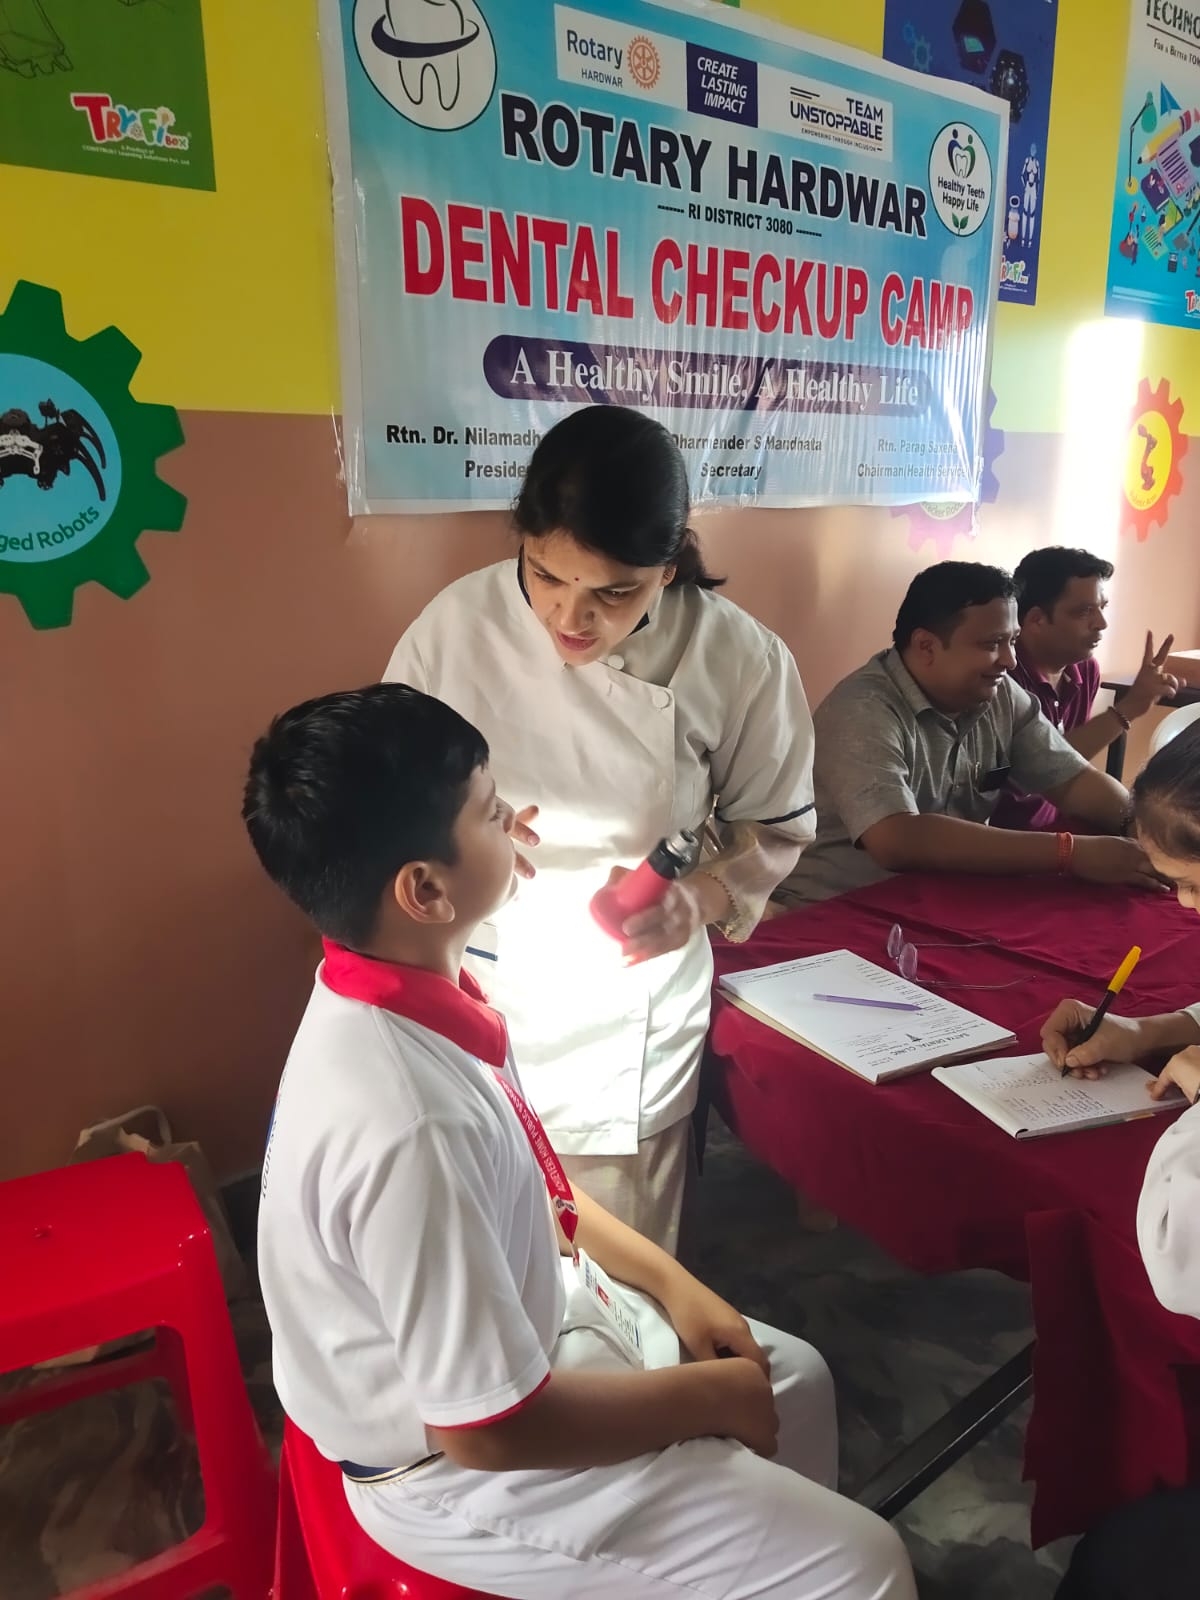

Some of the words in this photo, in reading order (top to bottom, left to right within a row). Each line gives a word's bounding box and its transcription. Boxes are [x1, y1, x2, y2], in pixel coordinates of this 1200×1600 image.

[566, 29, 623, 70] Rotary
[581, 68, 623, 88] HARDWAR
[697, 56, 739, 80] CREATE
[701, 75, 747, 99] LASTING
[704, 92, 746, 115] IMPACT
[847, 97, 883, 123] TEAM
[790, 100, 883, 141] UNSTOPPABLE
[501, 92, 713, 193] ROTARY
[728, 145, 927, 237] HARDWAR
[937, 176, 965, 197] Healthy
[966, 184, 985, 200] Teeth
[942, 191, 965, 211] Happy
[966, 197, 979, 212] Life
[688, 203, 701, 220] RI
[704, 207, 763, 230] DISTRICT
[766, 216, 793, 235] 3080
[400, 196, 634, 319] DENTAL
[651, 238, 869, 341] CHECKUP
[880, 273, 974, 351] CAMP
[510, 347, 536, 385] A
[546, 350, 660, 402] Healthy
[666, 360, 748, 399] Smile,
[755, 367, 776, 399] A
[785, 368, 873, 411] Healthy
[879, 375, 919, 406] Life
[386, 425, 426, 444] Rtn.
[433, 426, 458, 445] Dr.
[878, 439, 897, 452] Rtn.
[900, 440, 926, 456] Parag
[701, 463, 763, 480] Secretary
[857, 463, 935, 480] Chairman(Health
[36, 506, 99, 549] Robots
[520, 1107, 542, 1139] PUBLIC
